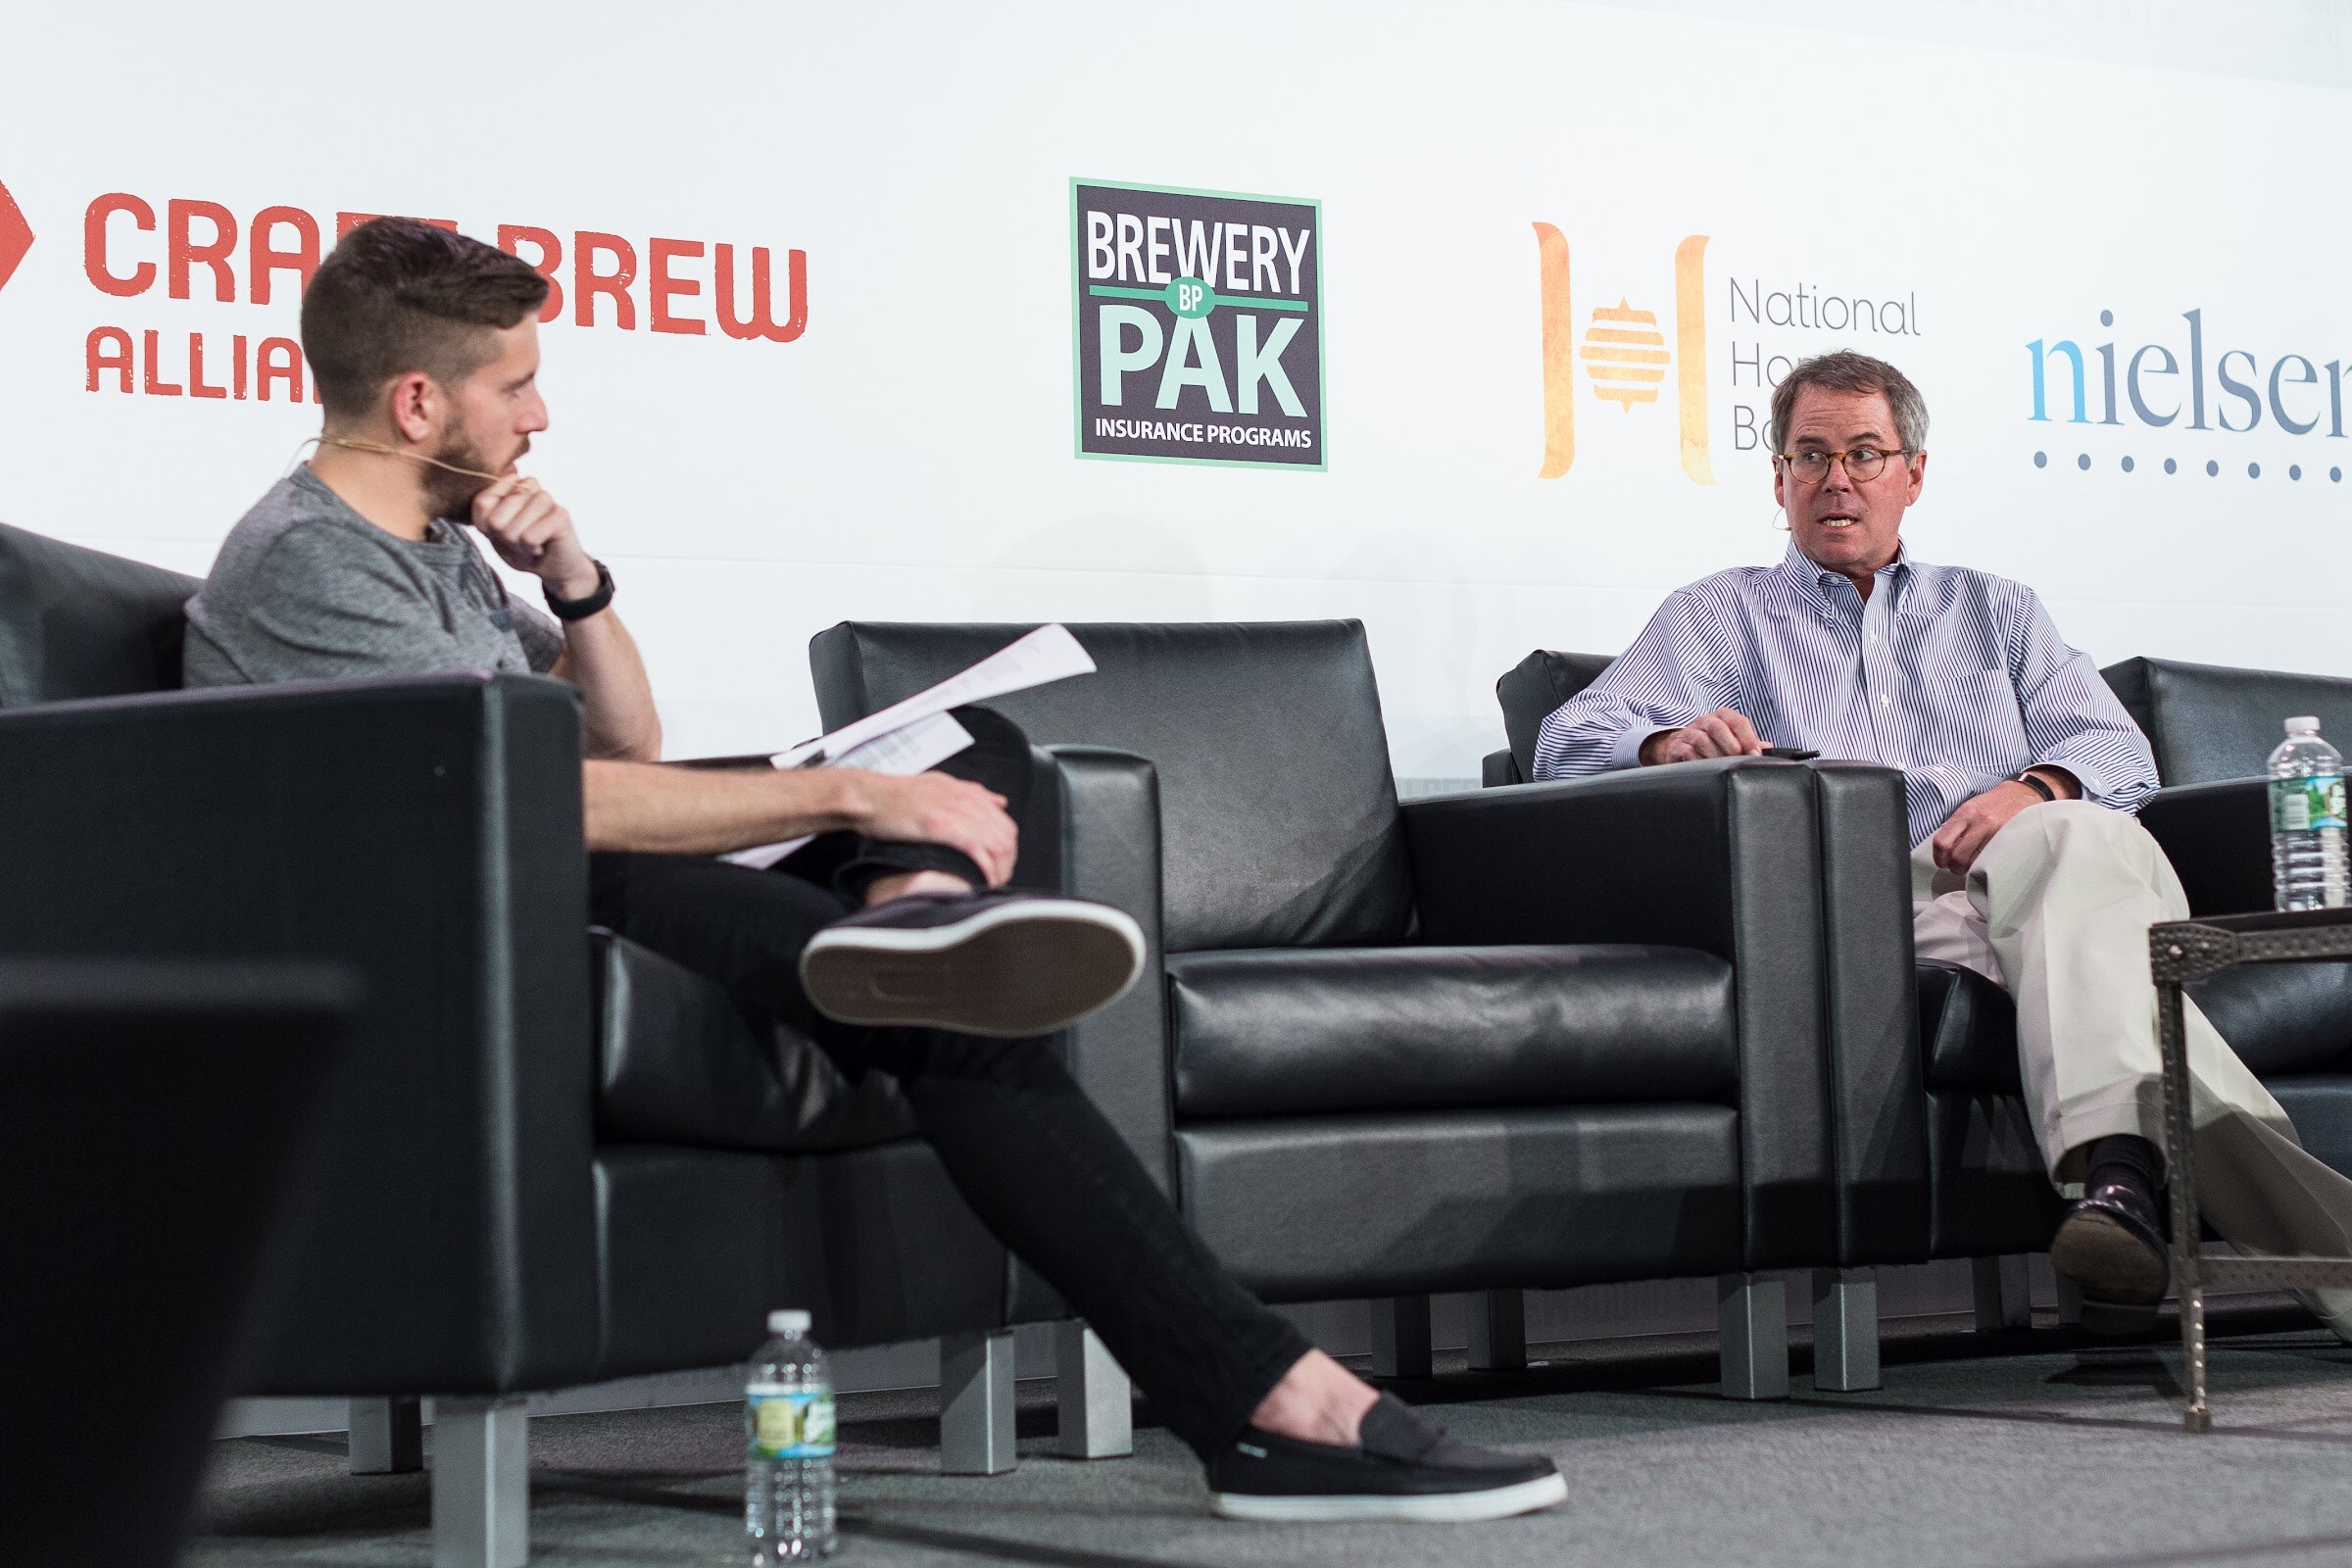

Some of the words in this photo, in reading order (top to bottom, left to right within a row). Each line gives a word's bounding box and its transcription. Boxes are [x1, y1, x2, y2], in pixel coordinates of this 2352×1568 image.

[84, 192, 458, 304] CRA
[1087, 210, 1311, 295] BREWERY
[1178, 283, 1203, 312] BP
[1730, 276, 1921, 336] National
[85, 326, 320, 403] ALLIA
[1099, 304, 1308, 417] PAK
[1095, 417, 1204, 443] INSURANCE
[1206, 424, 1312, 449] PROGRAMS
